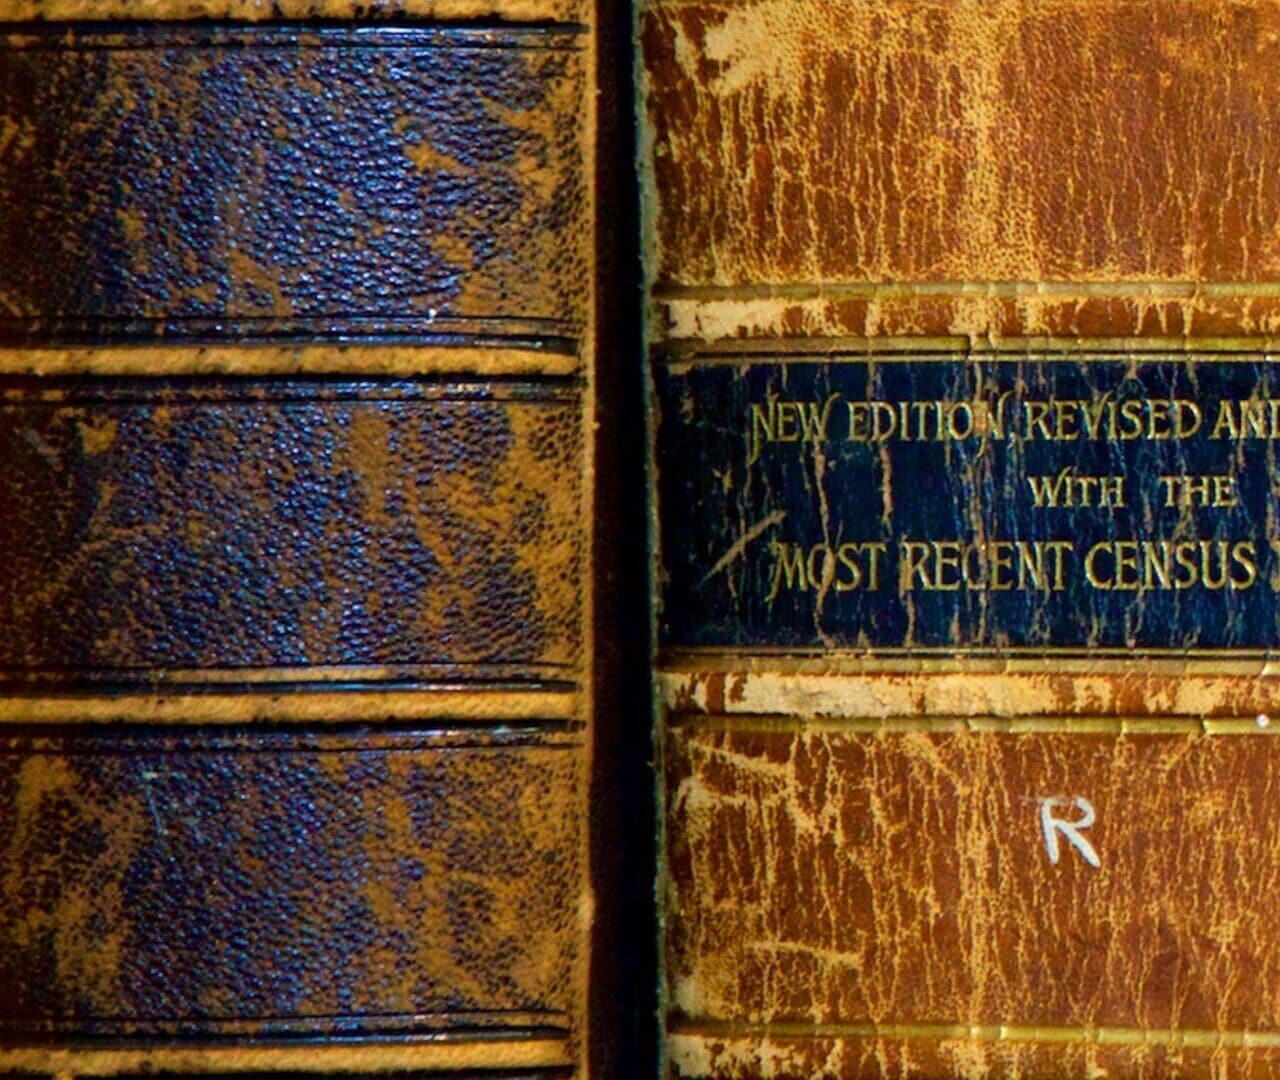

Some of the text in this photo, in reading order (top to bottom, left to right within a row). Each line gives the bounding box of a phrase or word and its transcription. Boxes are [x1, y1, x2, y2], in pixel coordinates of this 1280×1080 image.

[751, 393, 841, 465] NEW
[1025, 392, 1200, 441] REVISED
[1027, 466, 1238, 507] WITH THE
[764, 542, 886, 604] MOST
[901, 540, 1074, 591] RECENT
[1085, 539, 1257, 591] CENSUS
[1040, 797, 1101, 867] R
